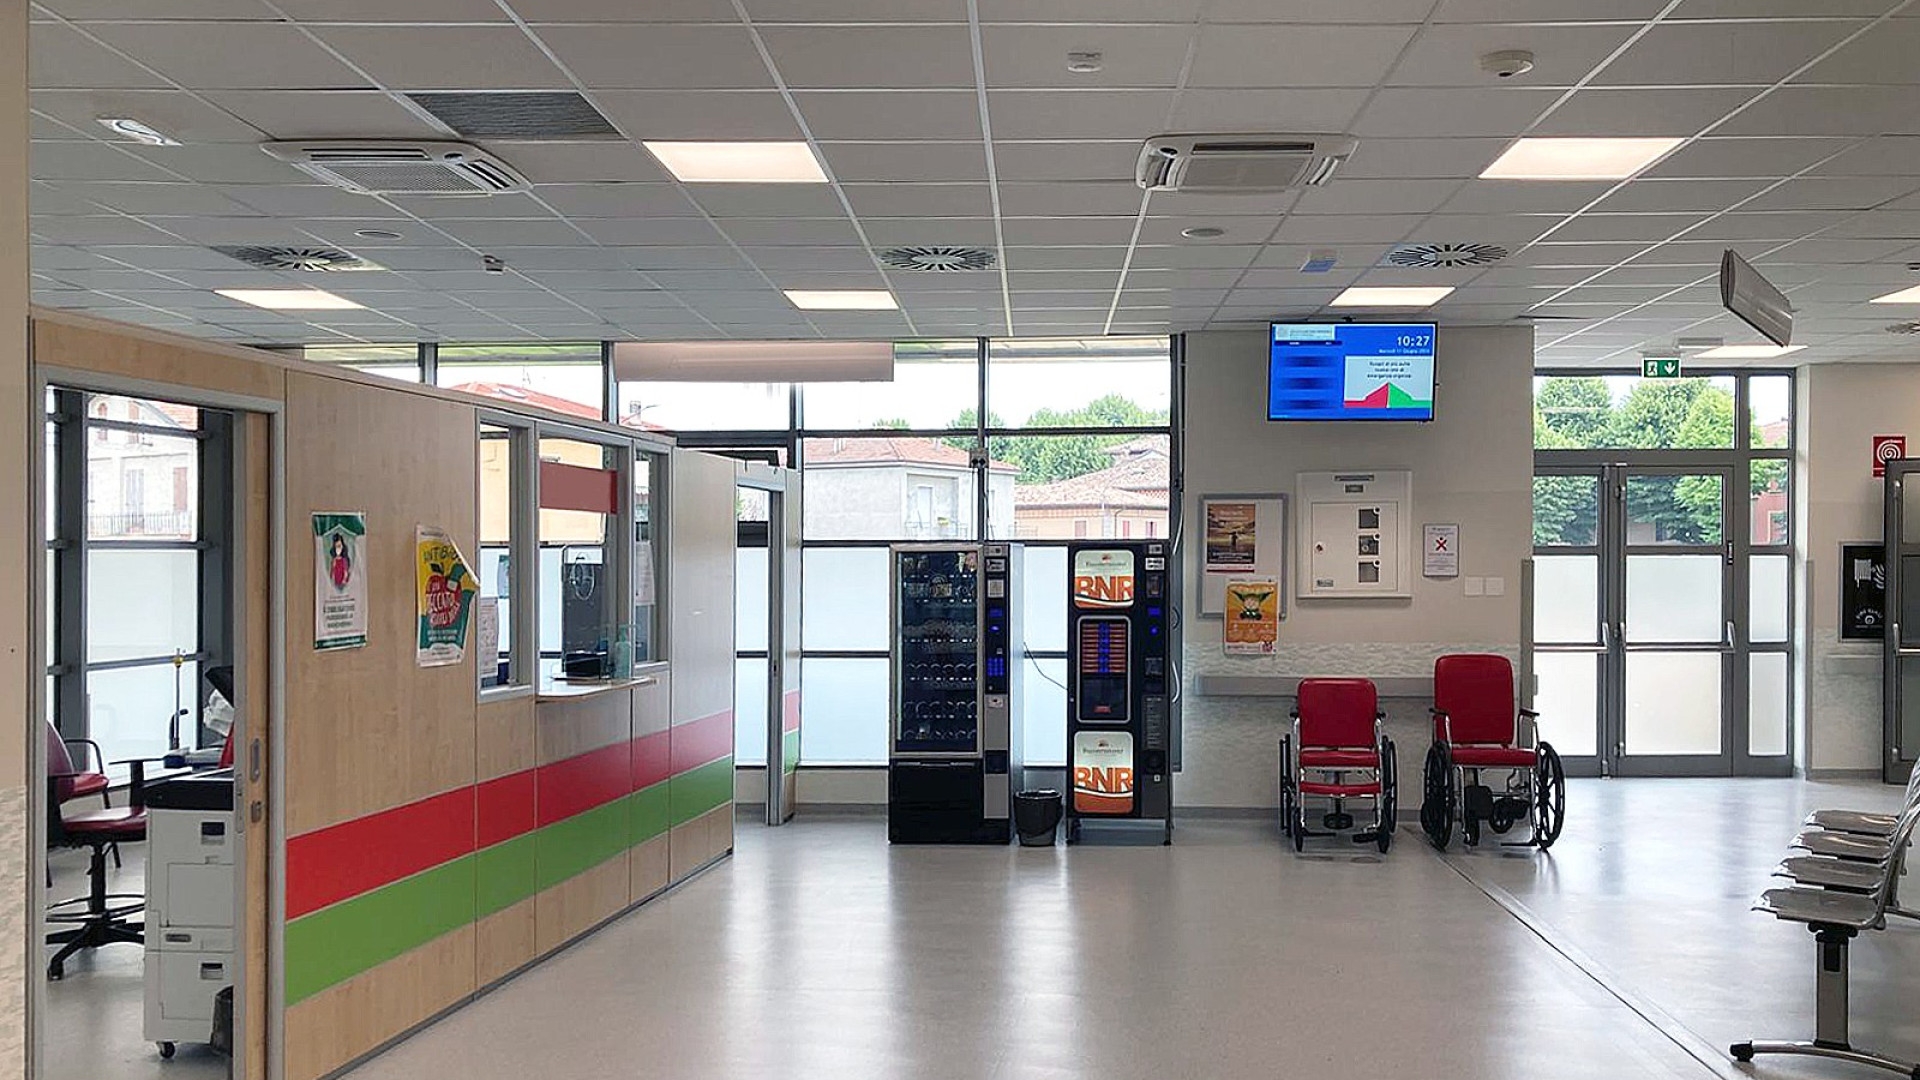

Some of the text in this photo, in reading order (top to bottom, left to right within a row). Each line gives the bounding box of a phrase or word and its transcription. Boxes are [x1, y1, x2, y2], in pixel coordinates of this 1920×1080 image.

[1397, 335, 1430, 346] 10:27
[1075, 576, 1135, 601] BNR
[1074, 767, 1134, 793] BNR
